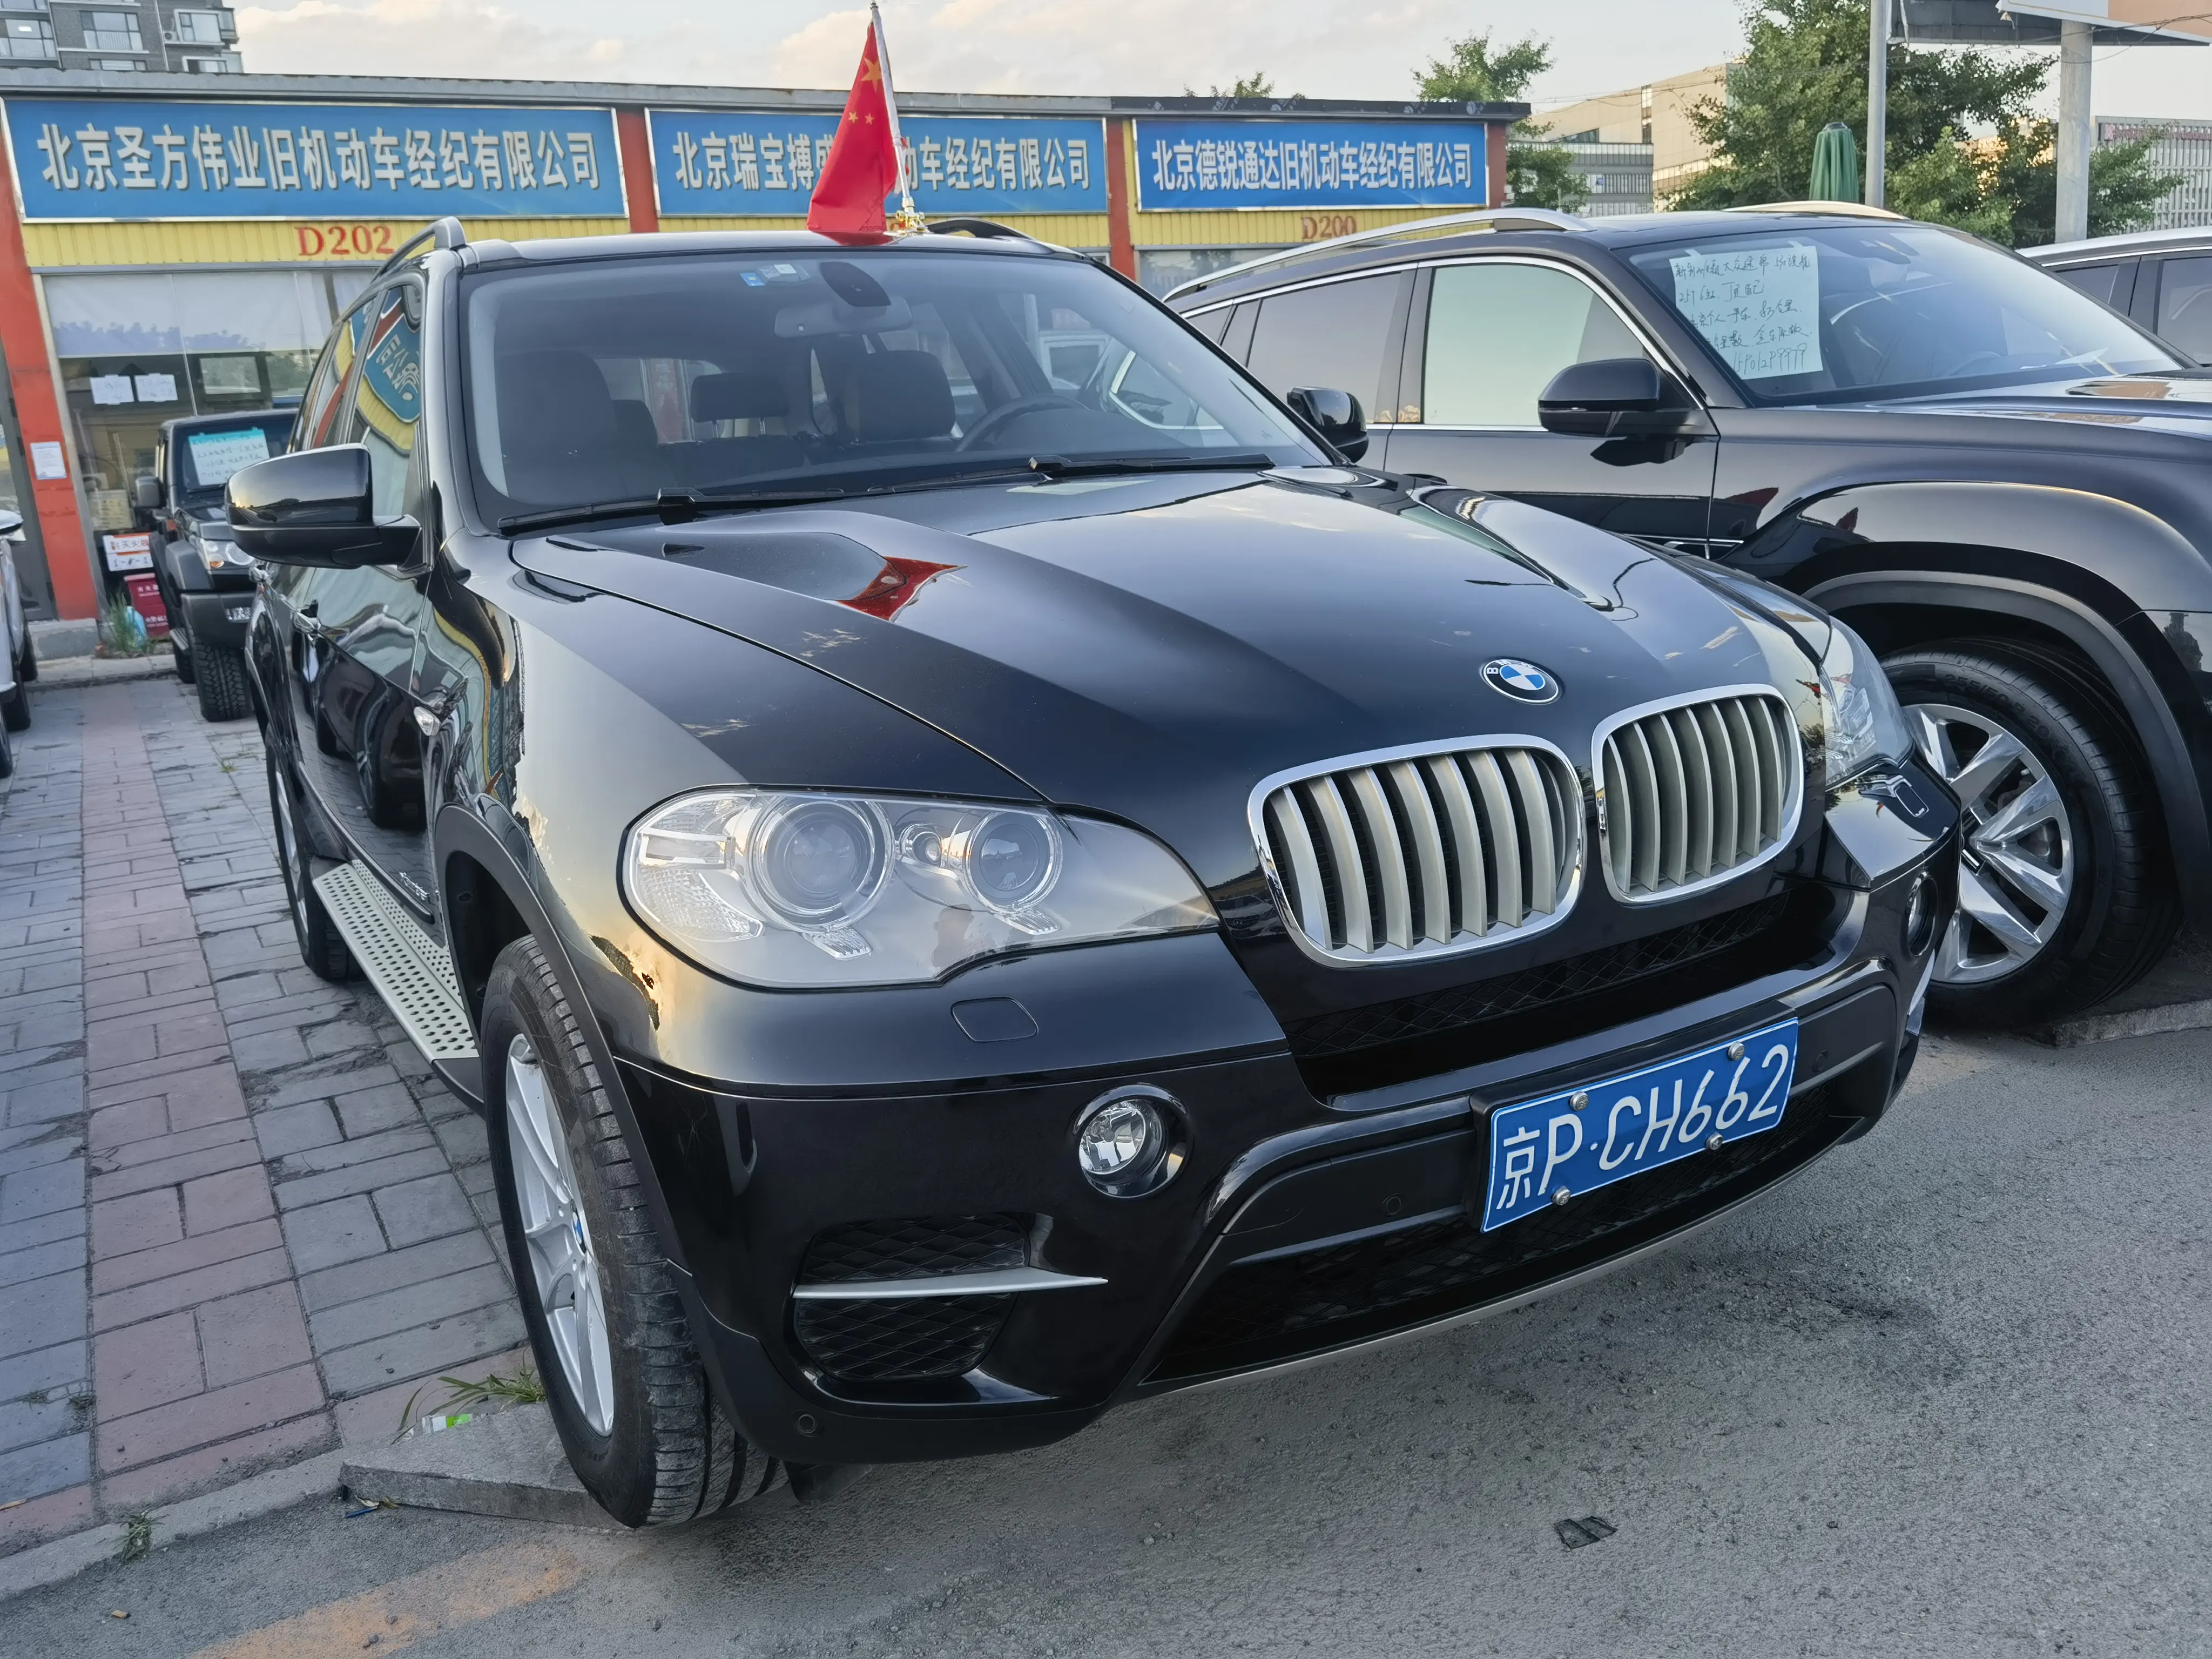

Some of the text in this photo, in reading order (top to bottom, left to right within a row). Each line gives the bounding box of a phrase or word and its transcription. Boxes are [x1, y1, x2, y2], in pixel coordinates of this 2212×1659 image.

[37, 123, 601, 191] 北京圣方伟业旧机动车经纪有限公司
[672, 131, 1090, 192] 北京瑞宝搏车经纪有限公司
[1152, 139, 1472, 192] 北京德锐通达旧机动车经纪有限公司
[294, 225, 394, 256] D202
[1300, 215, 1357, 239] D200
[1496, 1043, 1789, 1210] 京P·CH662
